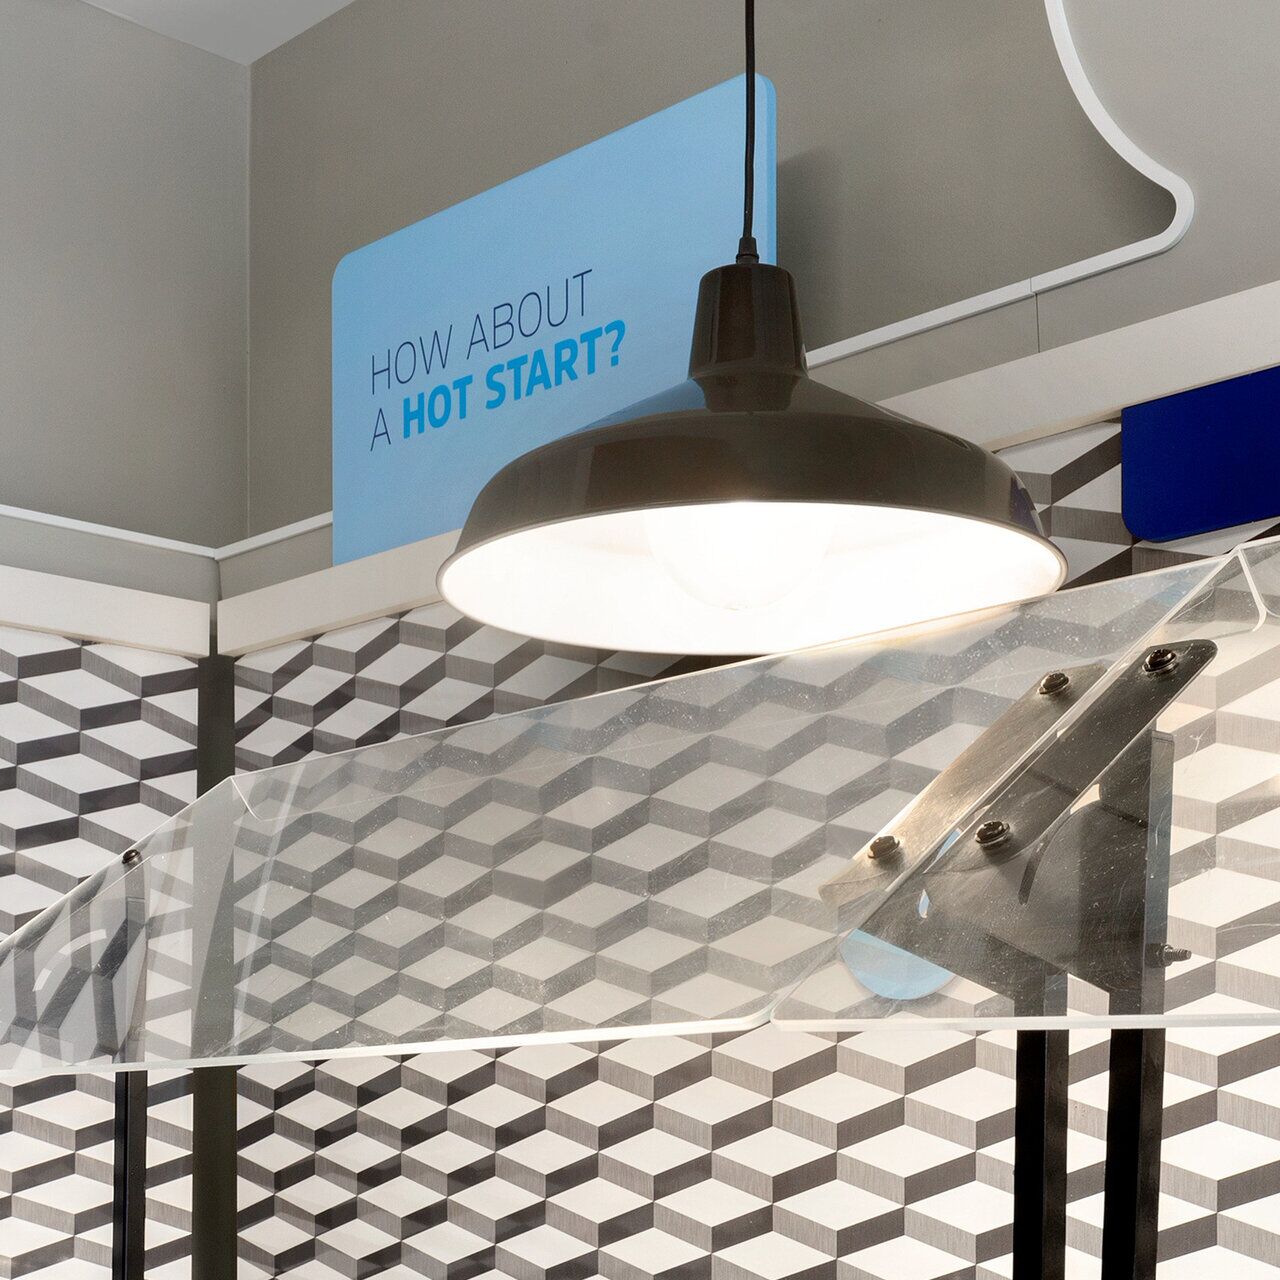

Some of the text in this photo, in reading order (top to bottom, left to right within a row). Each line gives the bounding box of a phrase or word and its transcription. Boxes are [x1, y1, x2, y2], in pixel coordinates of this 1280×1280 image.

[370, 319, 626, 452] A HOT START?
[371, 268, 593, 395] HOW ABOUT
